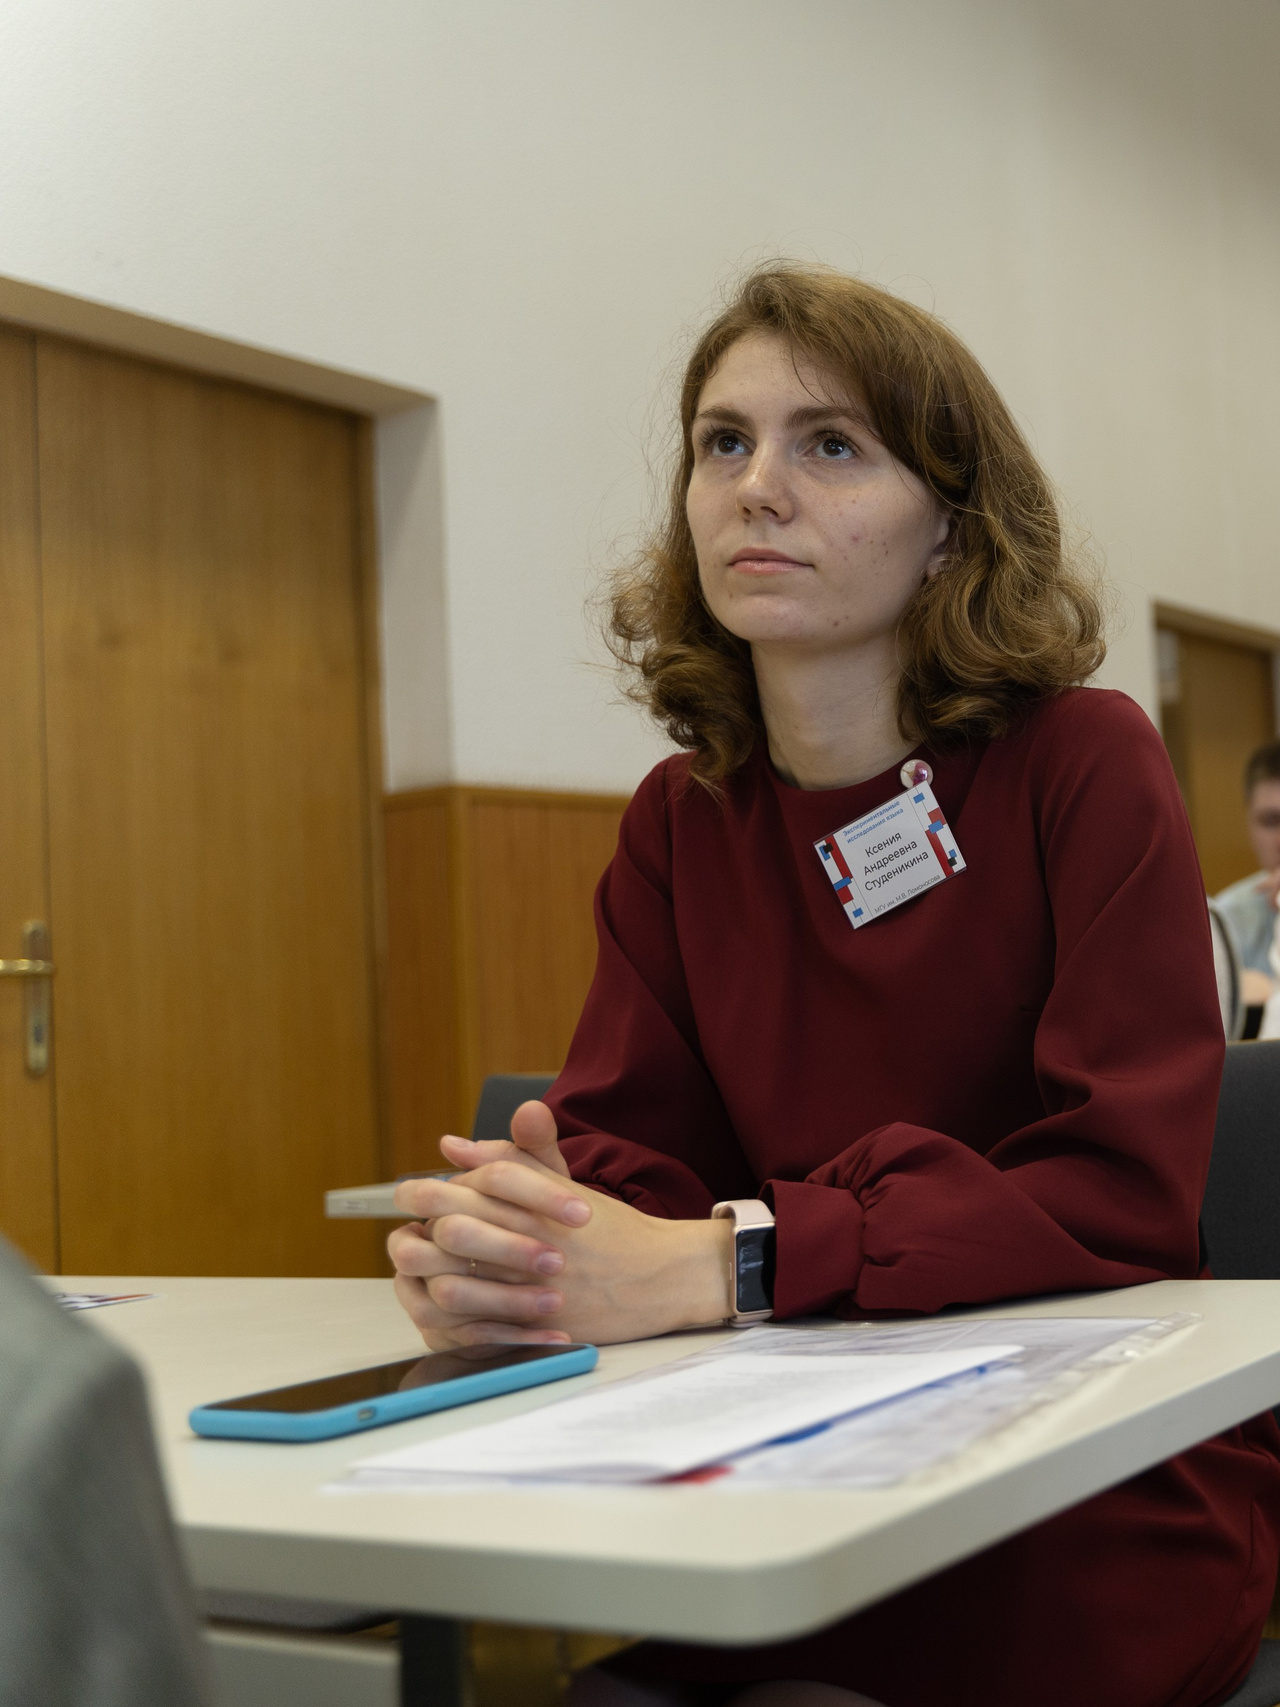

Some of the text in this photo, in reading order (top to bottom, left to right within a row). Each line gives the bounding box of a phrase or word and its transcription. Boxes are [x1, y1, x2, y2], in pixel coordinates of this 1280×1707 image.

[843, 800, 900, 836] Экспериментальные
[847, 808, 904, 843] исследования языка
[864, 840, 918, 876] Андреевна
[865, 832, 902, 857] Ксения
[865, 851, 929, 891] Студеникина
[874, 903, 886, 914] МГУ
[907, 874, 940, 895] Ломоносова
